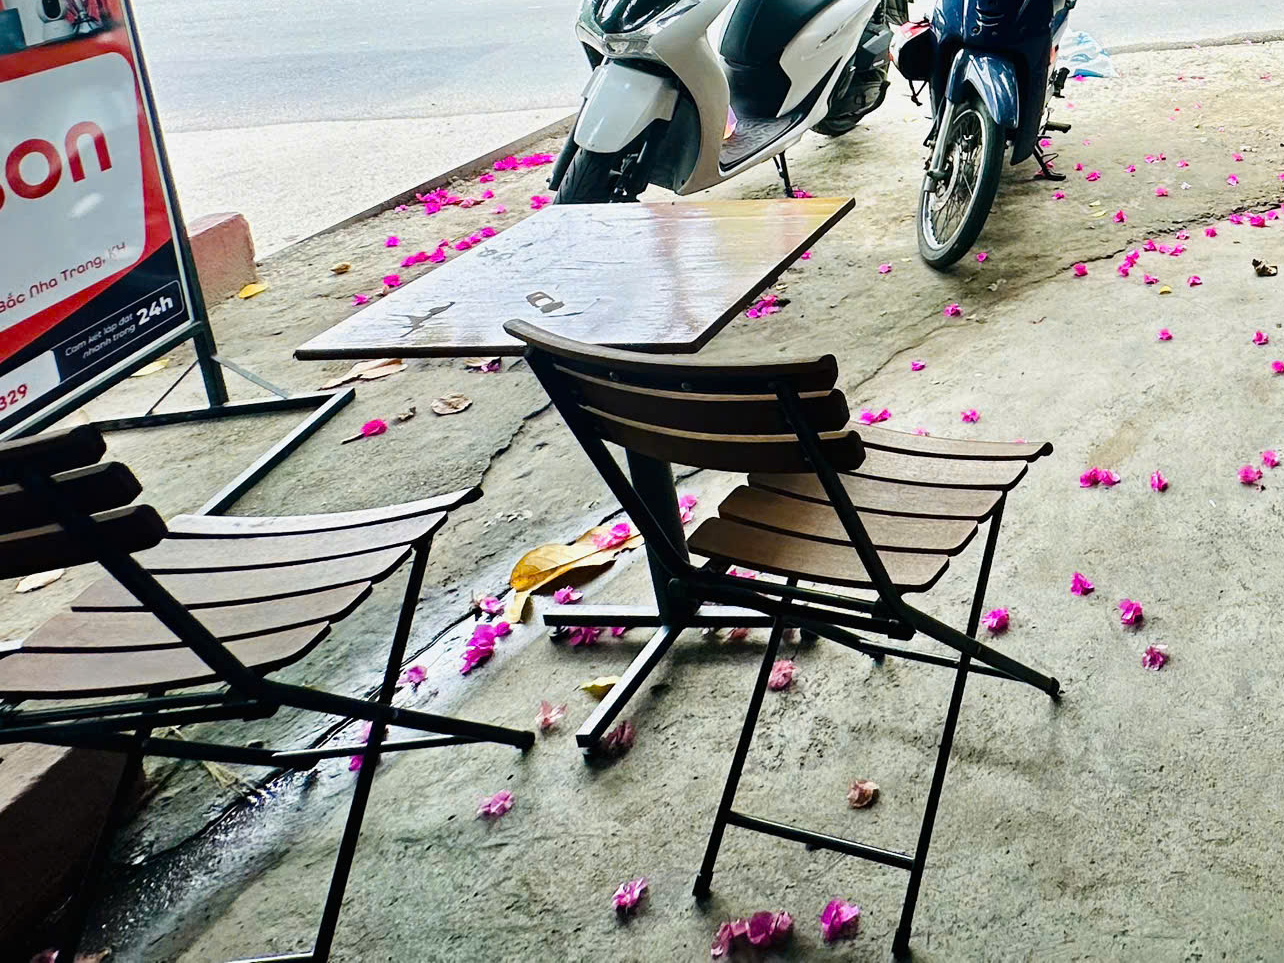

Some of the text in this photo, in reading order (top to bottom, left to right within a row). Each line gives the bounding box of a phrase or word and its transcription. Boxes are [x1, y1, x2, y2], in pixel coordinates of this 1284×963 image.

[0, 121, 112, 210] on
[61, 256, 106, 282] Trang,
[136, 296, 174, 326] 24h
[65, 340, 87, 357] Cam
[82, 325, 136, 359] nhanh trong
